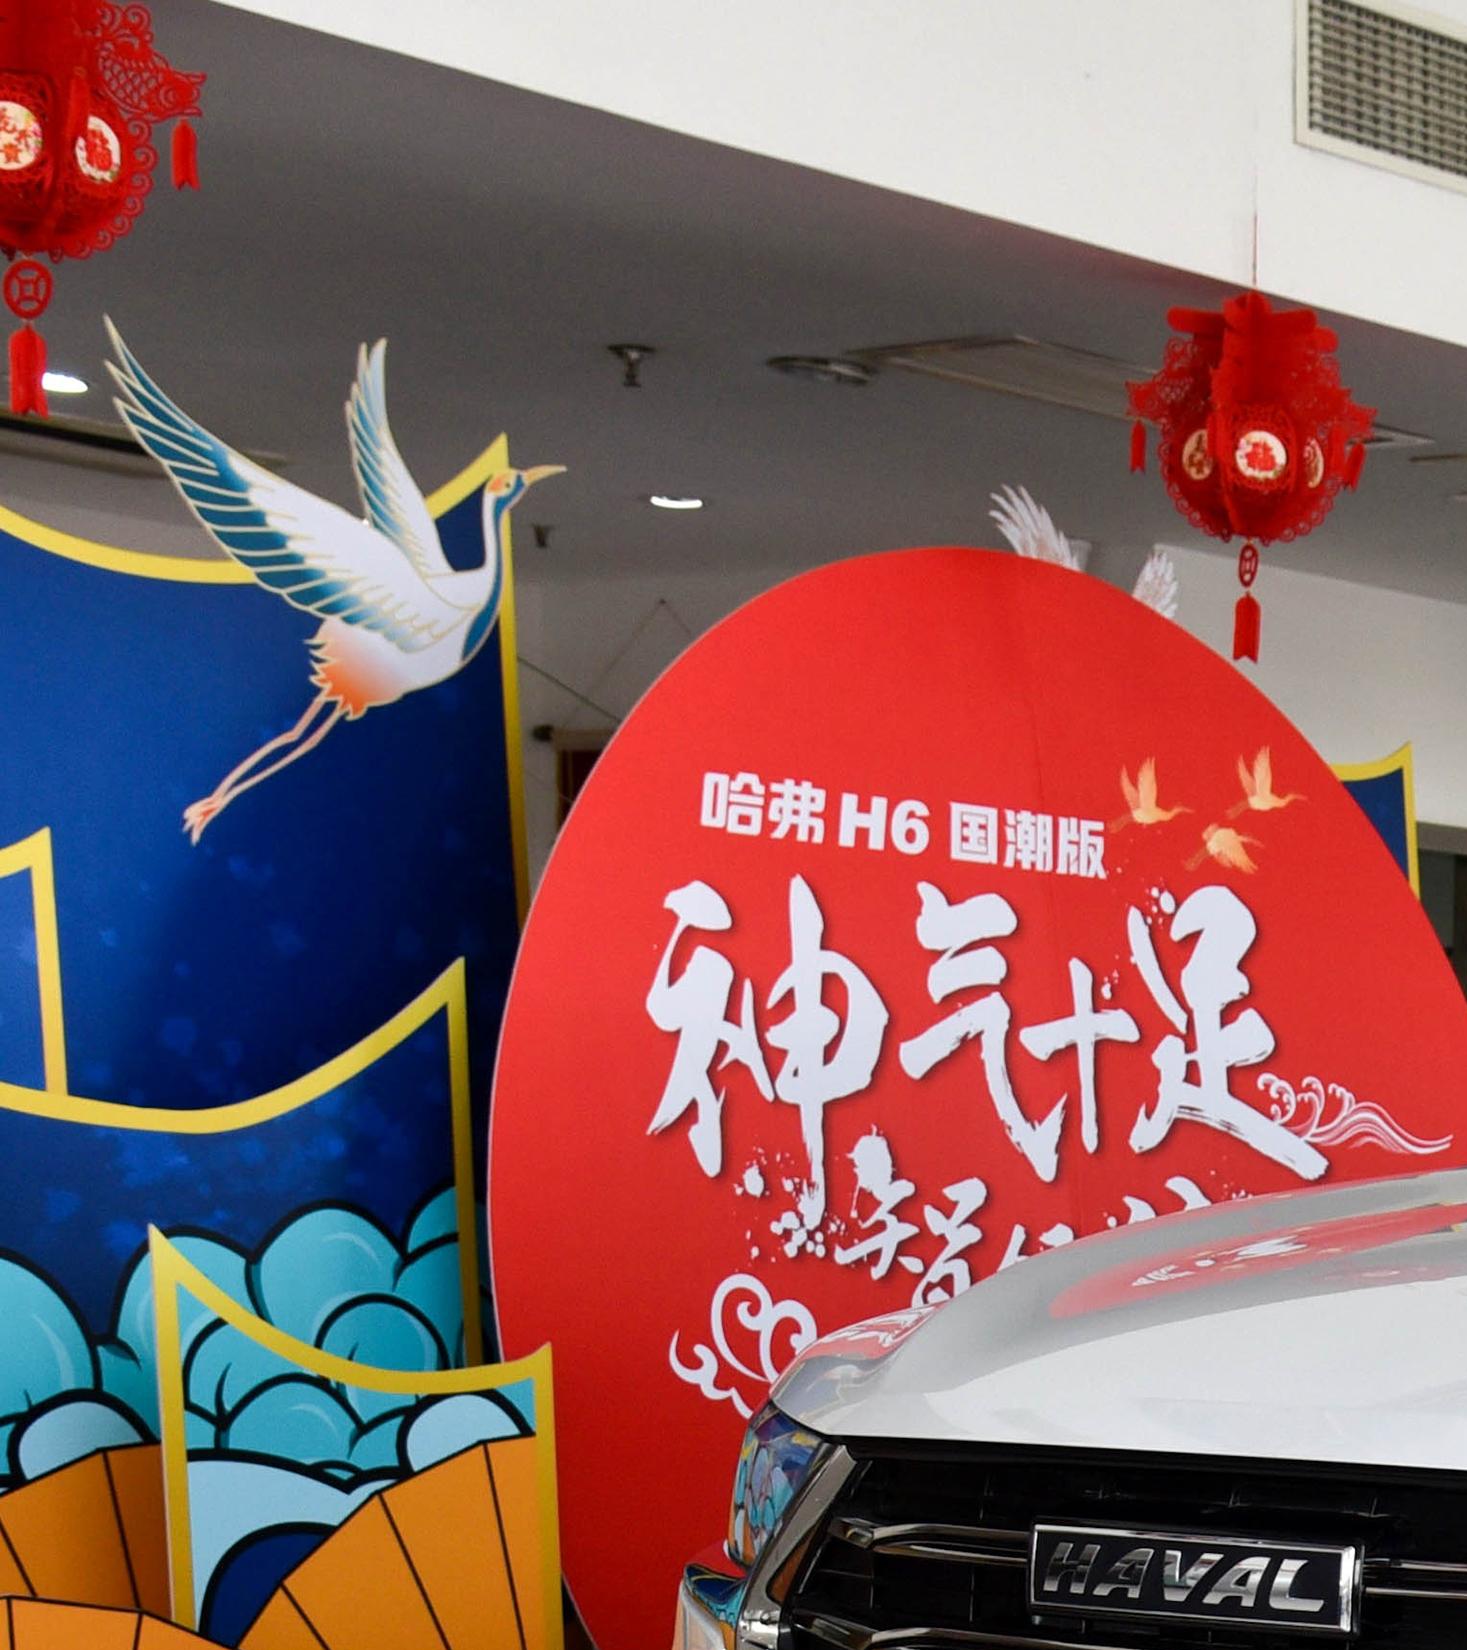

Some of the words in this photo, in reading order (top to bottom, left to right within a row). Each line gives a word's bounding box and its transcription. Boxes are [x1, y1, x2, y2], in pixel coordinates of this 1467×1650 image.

[700, 772, 826, 844] 哈弗
[838, 792, 930, 855] H6
[950, 801, 1107, 879] 国潮版
[646, 874, 1328, 1227] 神气十足
[1043, 1542, 1325, 1612] HAVAL
